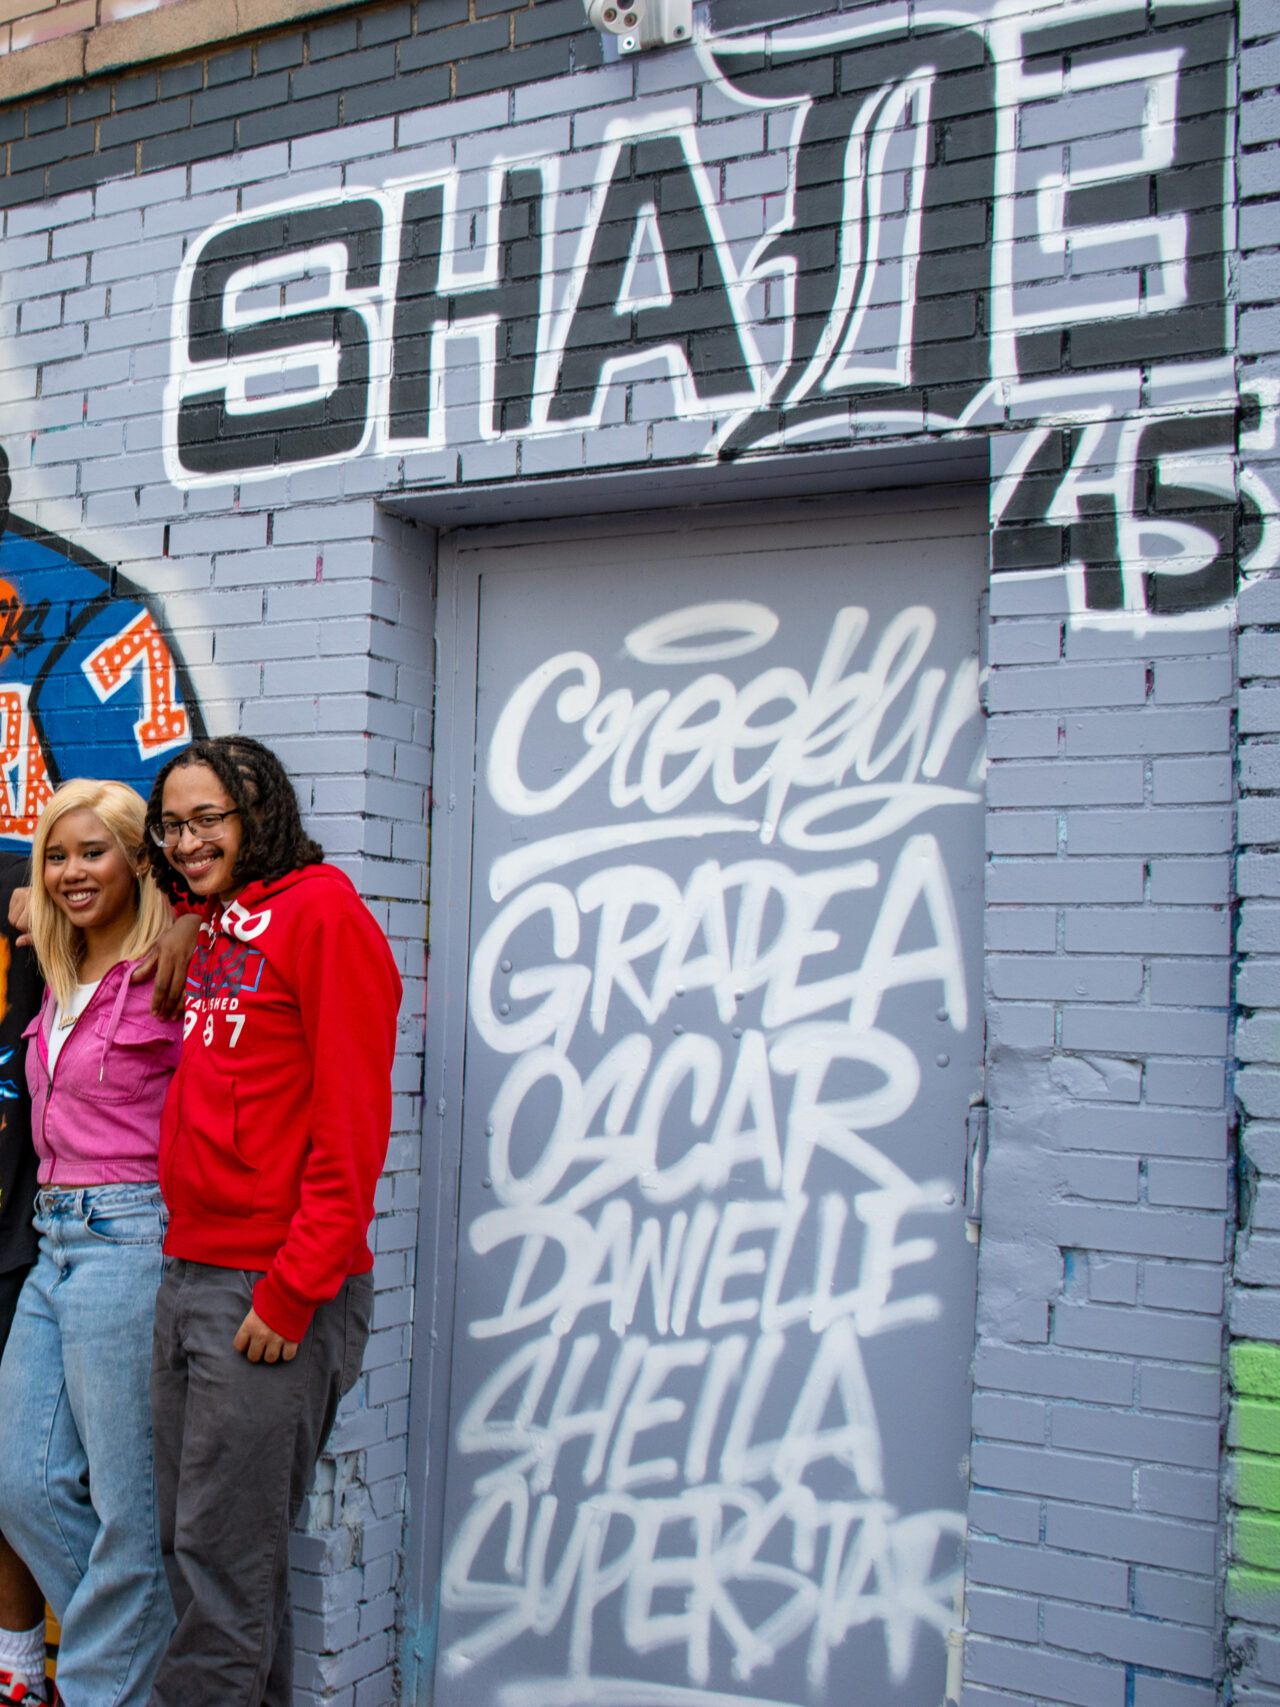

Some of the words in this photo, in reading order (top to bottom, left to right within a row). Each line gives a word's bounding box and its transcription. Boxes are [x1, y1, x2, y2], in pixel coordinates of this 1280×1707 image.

[988, 388, 1280, 638] 45
[183, 1009, 246, 1048] 987
[489, 1023, 956, 1212] OSCAR
[468, 1188, 945, 1339] DANIELLE
[456, 1316, 886, 1500] SHEILA
[440, 1476, 968, 1692] SUPERSTAR
